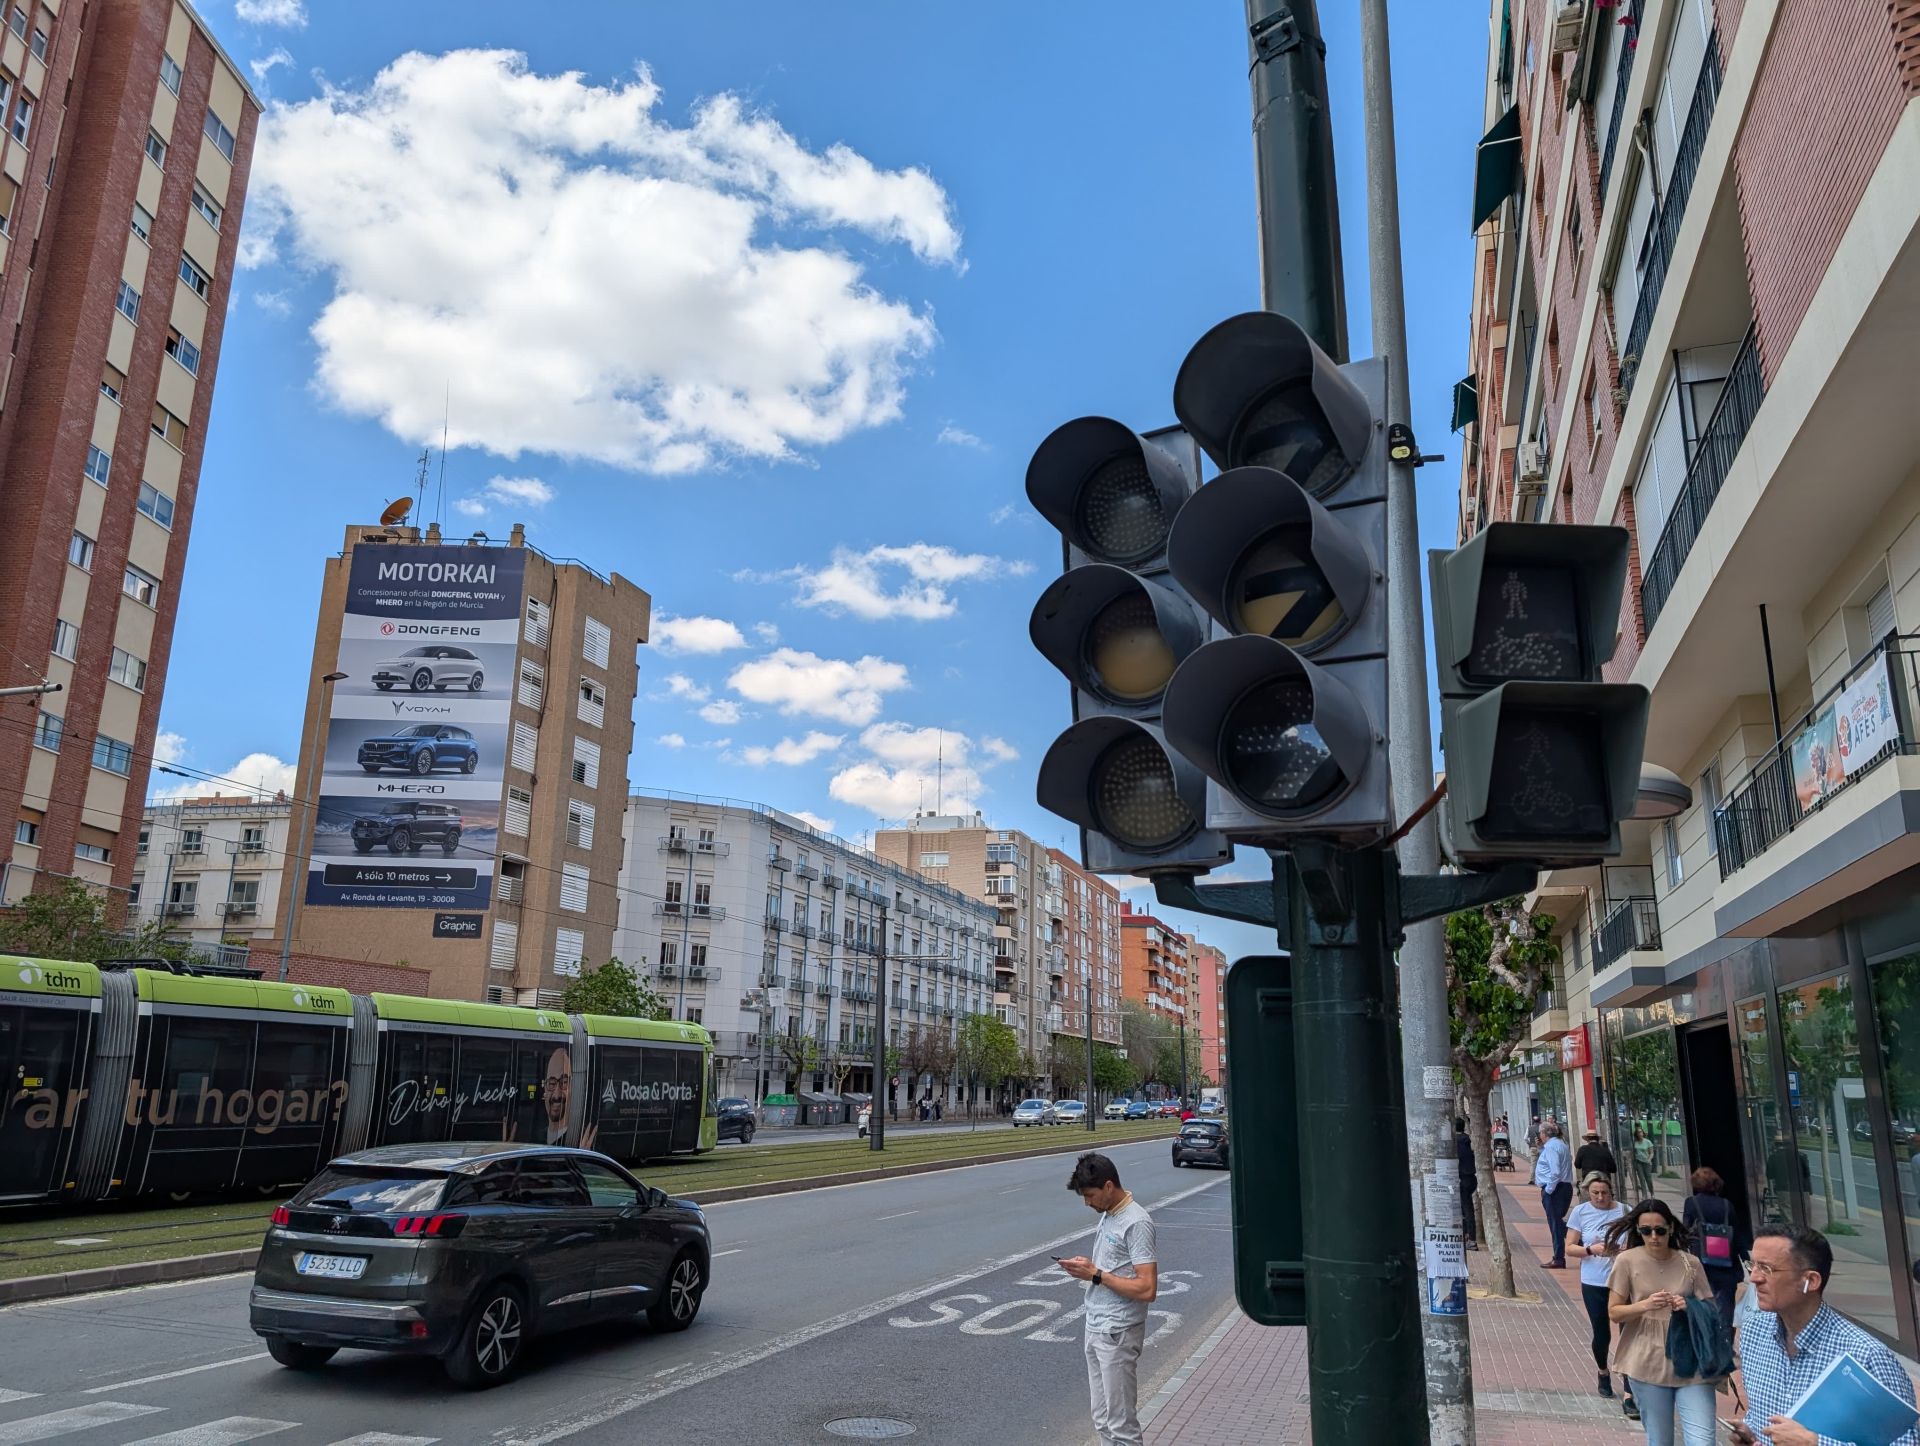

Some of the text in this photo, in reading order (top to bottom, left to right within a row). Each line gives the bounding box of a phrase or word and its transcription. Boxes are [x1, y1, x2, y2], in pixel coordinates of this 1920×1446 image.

[378, 562, 496, 584] MOTORKAI
[358, 588, 407, 597] Concesionario
[408, 589, 430, 598] oficial
[431, 591, 473, 600] DONGFENG,
[473, 592, 500, 600] VOYAH
[415, 599, 422, 607] la
[423, 600, 447, 609] Región
[448, 600, 458, 608] de
[398, 624, 481, 636] DONGFENG
[405, 705, 450, 714] VOYAH
[377, 783, 445, 794] MHERO
[356, 870, 430, 882] A sólo 10 metros
[340, 893, 351, 901] Av.
[352, 893, 375, 902] Ronda
[376, 894, 386, 902] de
[387, 894, 417, 903] Levante,
[431, 895, 456, 903] 30008
[439, 920, 477, 933] Graphic
[44, 971, 81, 989] tdm
[310, 994, 335, 1009] tdm
[549, 1018, 564, 1029] tdm
[621, 1081, 650, 1101] Rosa
[651, 1081, 660, 1101] &
[125, 1078, 176, 1126] tu
[195, 1076, 349, 1135] hogar?
[387, 1071, 517, 1127] Dicho y hecho
[309, 1256, 363, 1273] 5235 LLD
[1016, 1262, 1203, 1297] BS
